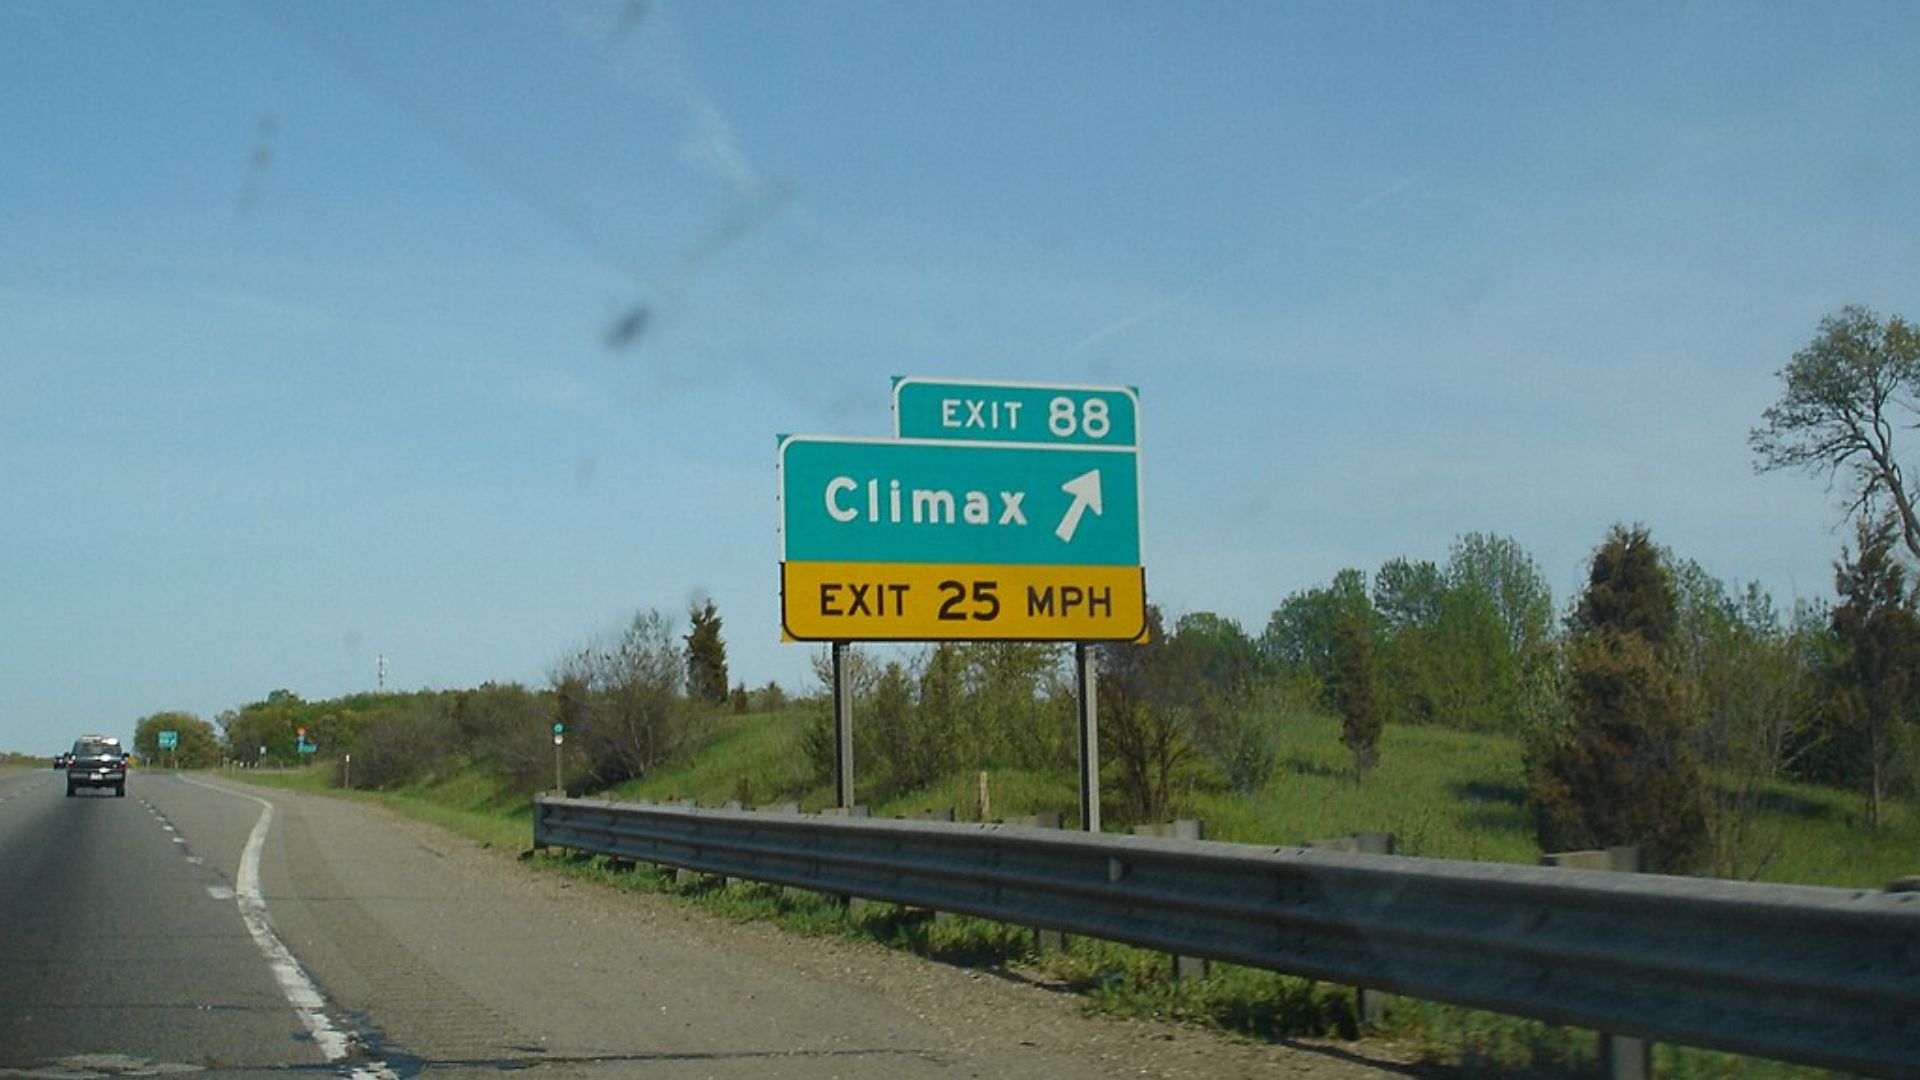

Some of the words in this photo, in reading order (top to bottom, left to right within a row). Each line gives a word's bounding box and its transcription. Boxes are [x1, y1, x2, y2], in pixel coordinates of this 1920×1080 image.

[943, 399, 1022, 429] EXIT
[1049, 397, 1110, 438] 88
[825, 476, 1027, 525] Climax
[819, 583, 911, 618] EXIT
[937, 579, 1001, 622] 25
[1026, 584, 1113, 619] MPH
